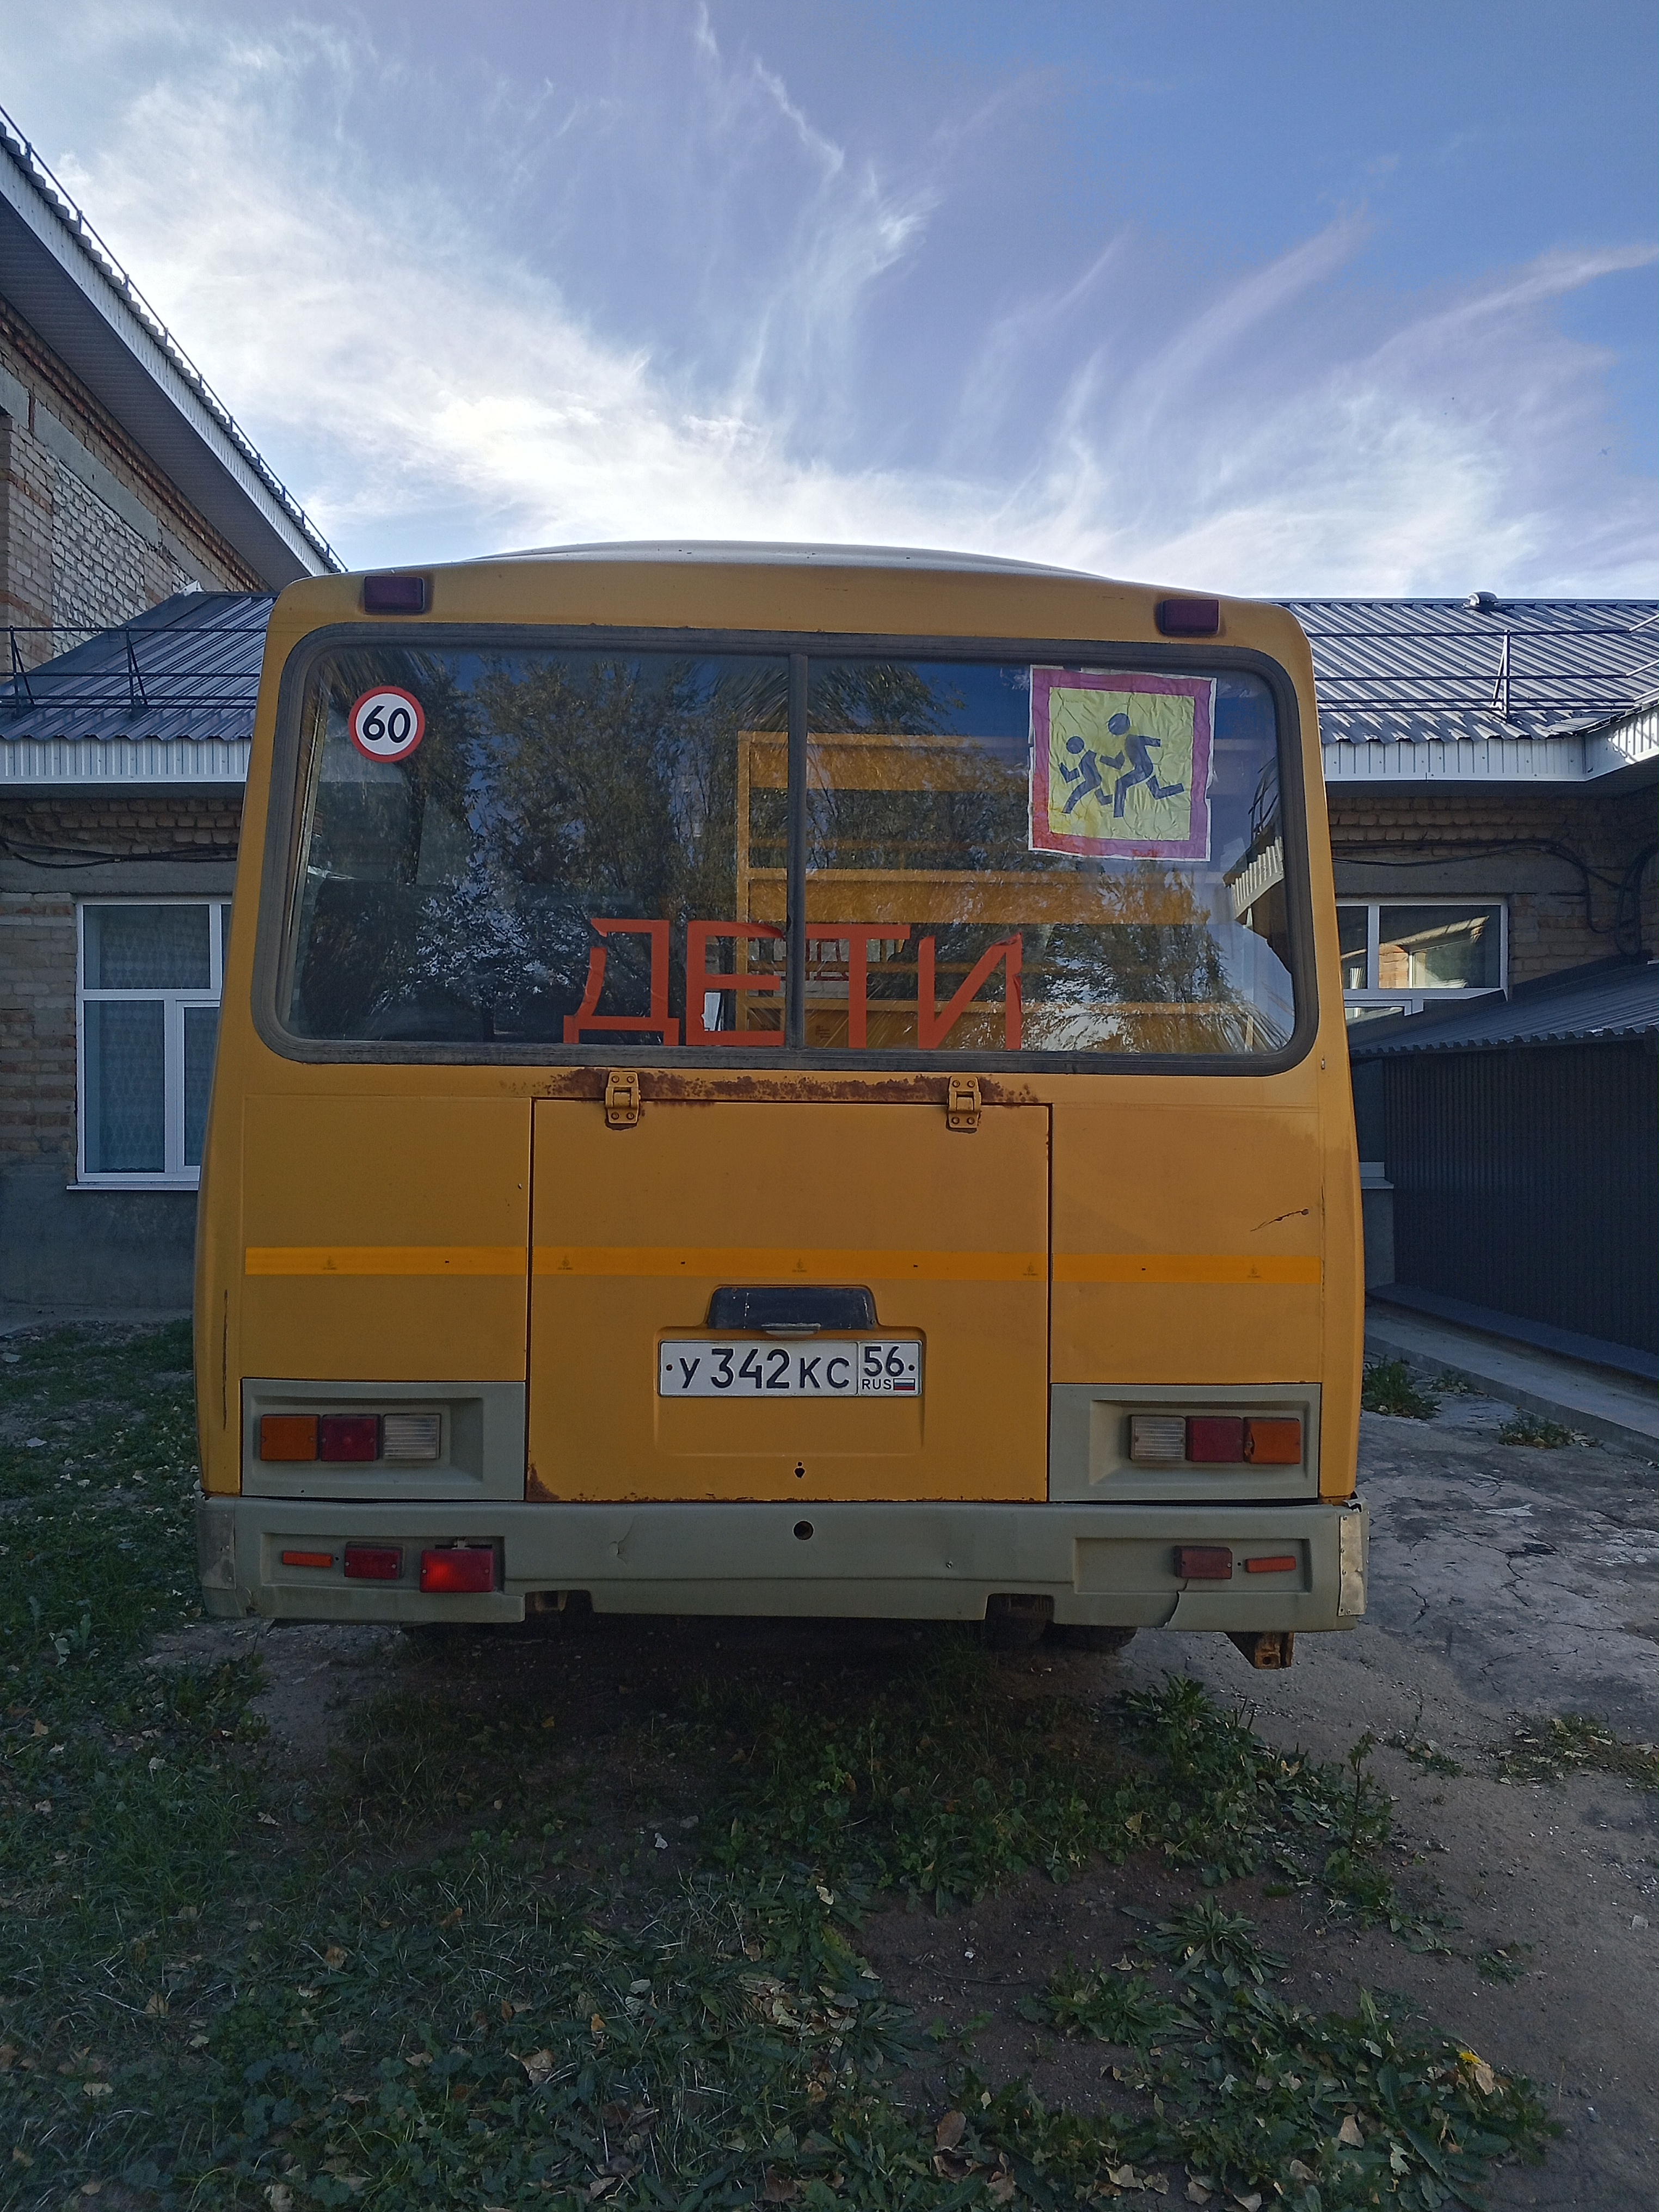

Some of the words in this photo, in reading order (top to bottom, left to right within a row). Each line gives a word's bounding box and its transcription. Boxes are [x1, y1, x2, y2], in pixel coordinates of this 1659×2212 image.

[362, 705, 411, 743] 60
[563, 918, 1021, 1049] ДЕТИ
[864, 1346, 904, 1377] 56
[862, 1379, 892, 1390] RUS
